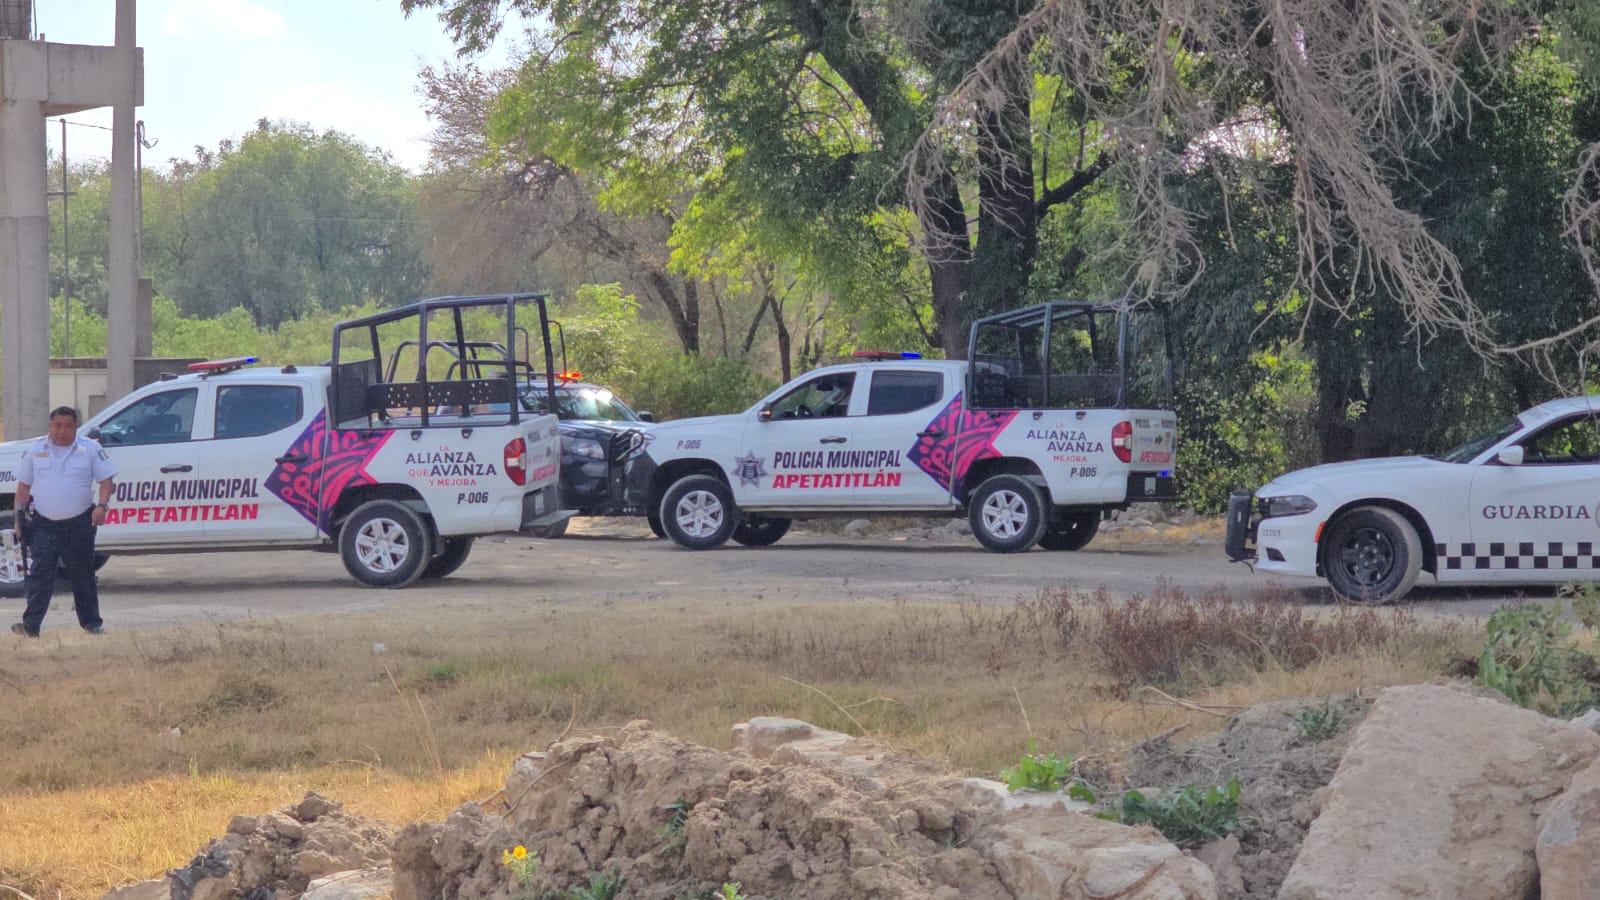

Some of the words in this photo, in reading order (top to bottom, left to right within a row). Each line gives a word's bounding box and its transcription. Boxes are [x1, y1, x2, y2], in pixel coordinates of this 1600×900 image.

[1026, 430, 1087, 441] ALIANZA
[1046, 441, 1105, 453] AVANZA
[405, 452, 476, 464] ALIANZA
[773, 451, 823, 469] POLICIA
[826, 450, 901, 468] MUNICIPAL
[1053, 455, 1087, 463] MEJORA
[408, 468, 429, 477] QUE
[430, 463, 497, 476] AVANZA
[1070, 466, 1098, 478] P-005
[437, 479, 477, 487] MEJORA
[772, 469, 902, 489] APETATITLÁN
[169, 478, 259, 500] MUNICIPAL
[457, 492, 489, 504] P-006
[1482, 505, 1591, 519] GUARDIA
